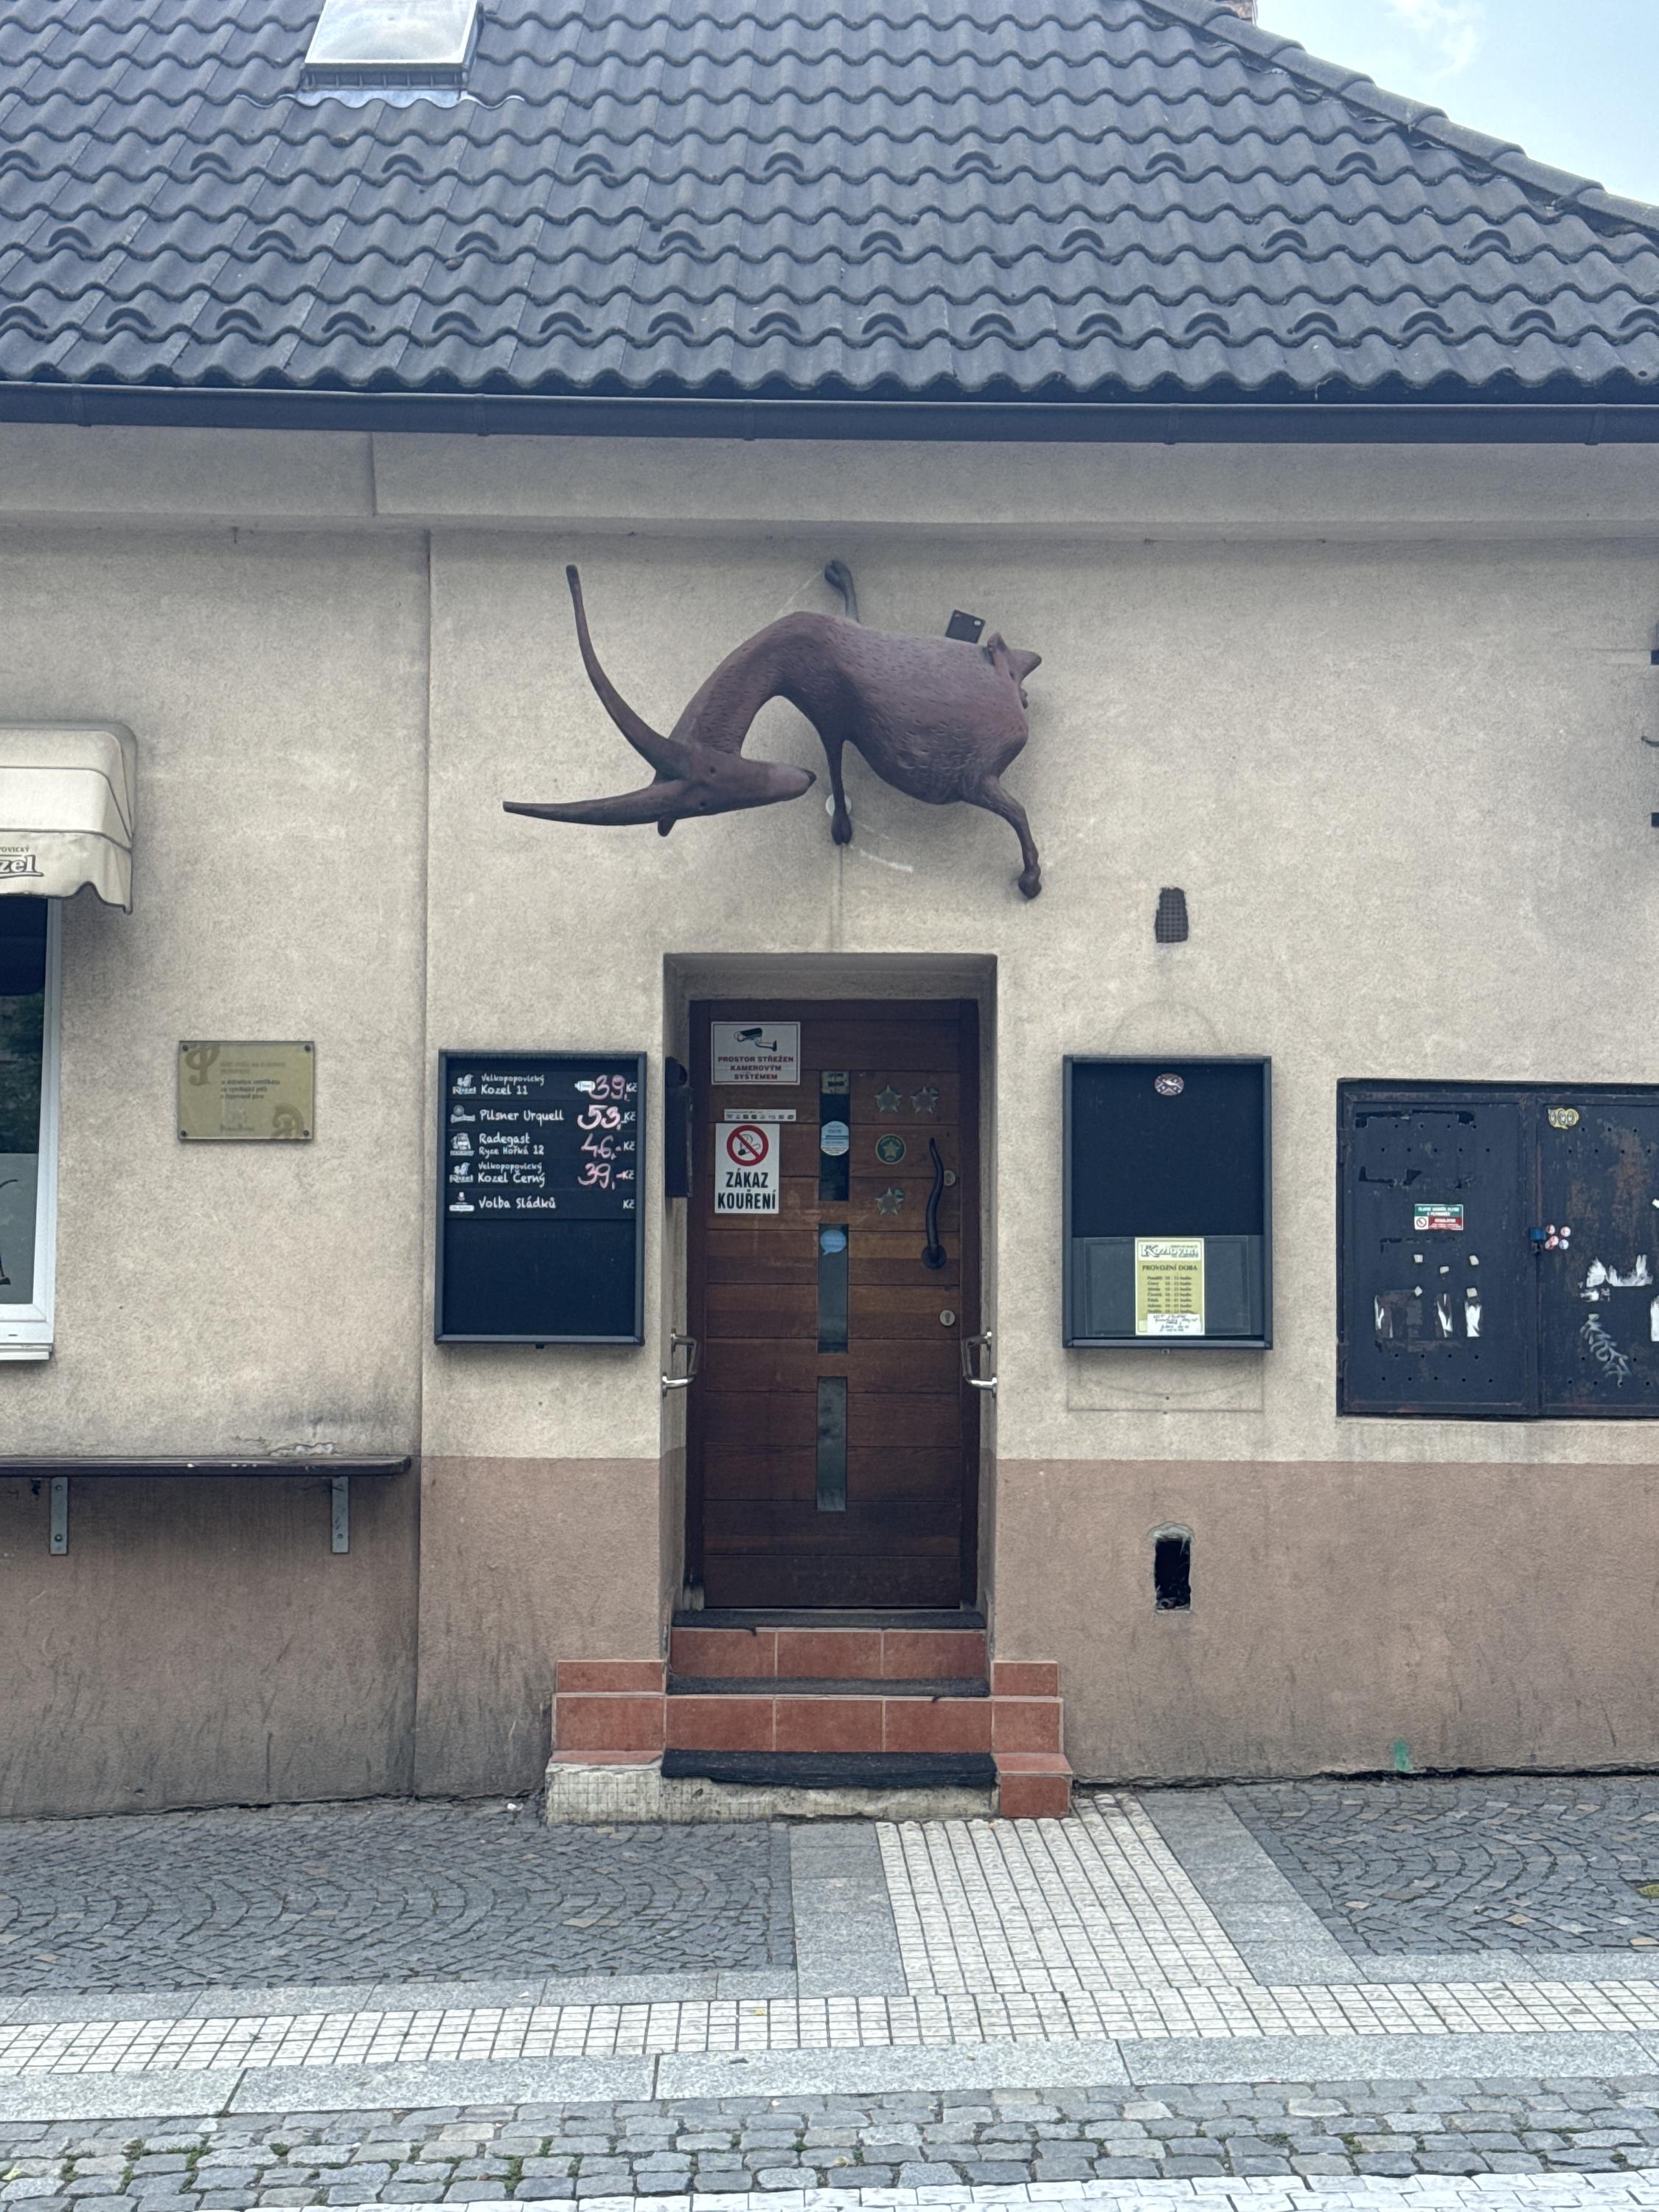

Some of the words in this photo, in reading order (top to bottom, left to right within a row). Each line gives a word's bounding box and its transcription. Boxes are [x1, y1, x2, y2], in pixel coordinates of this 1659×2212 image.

[0, 854, 36, 874] zel
[757, 1054, 794, 1062] STŘEŽEN
[481, 1073, 545, 1086] Velkopopovický
[481, 1084, 512, 1095] Kozel
[516, 1085, 529, 1095] 11
[626, 1082, 638, 1092] Kč
[479, 1109, 519, 1121] Pilsner
[524, 1110, 565, 1127] Urquell
[624, 1111, 636, 1121] Kč
[479, 1132, 530, 1147] Radegast
[503, 1144, 529, 1155] Hořká
[533, 1144, 545, 1155] 12
[623, 1141, 636, 1151] Kč
[478, 1161, 543, 1174] Velkopopovický
[478, 1172, 509, 1183] Kozel
[513, 1169, 546, 1188] Černý
[622, 1169, 635, 1180] Kč
[726, 1168, 768, 1188] ZÁKAZ
[479, 1195, 511, 1209] Volba
[516, 1195, 557, 1210] Sládků
[623, 1199, 635, 1209] Kč
[717, 1189, 776, 1209] KOUŘENÍ
[1142, 1263, 1177, 1271] PROVOZNÍ
